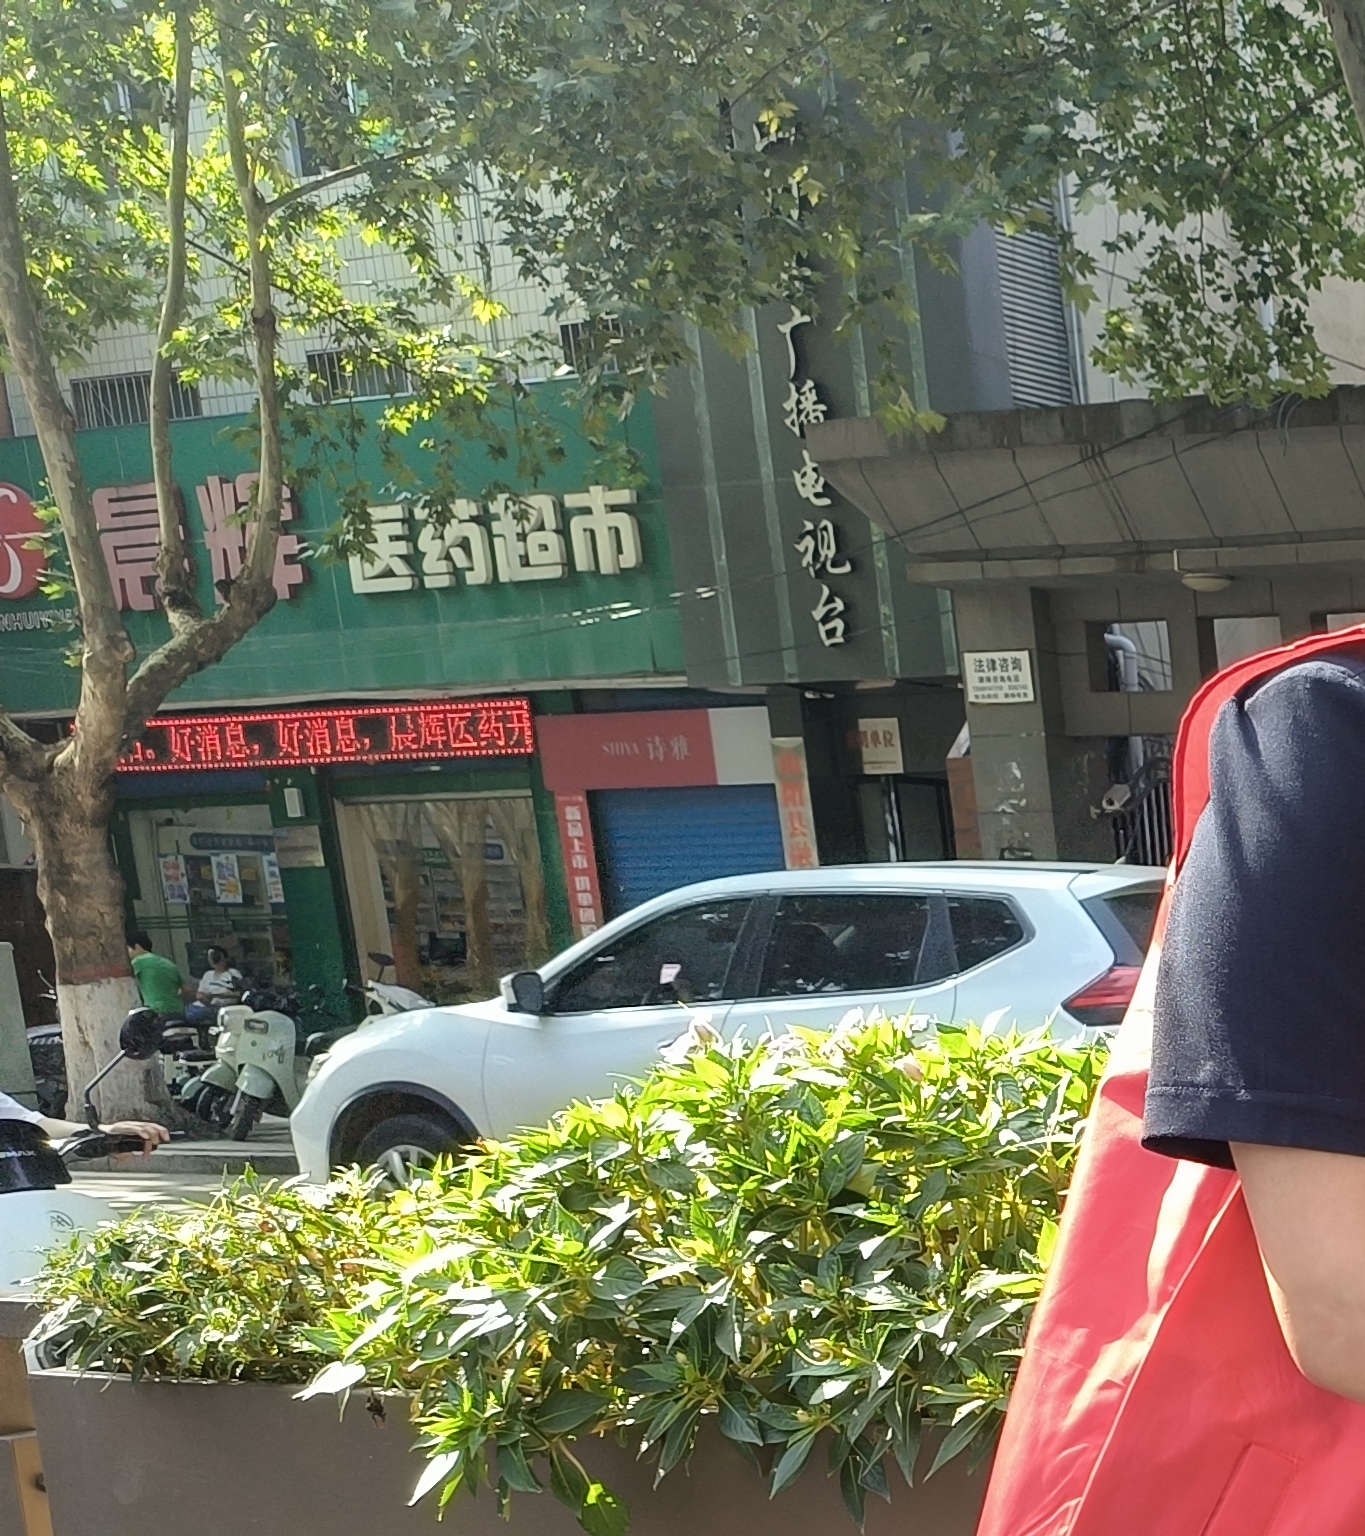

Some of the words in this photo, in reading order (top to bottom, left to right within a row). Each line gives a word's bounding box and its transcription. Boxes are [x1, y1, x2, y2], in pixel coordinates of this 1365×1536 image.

[777, 304, 851, 648] 广播电视台
[349, 486, 643, 595] 医药超市
[973, 656, 1022, 673] 法律咨询
